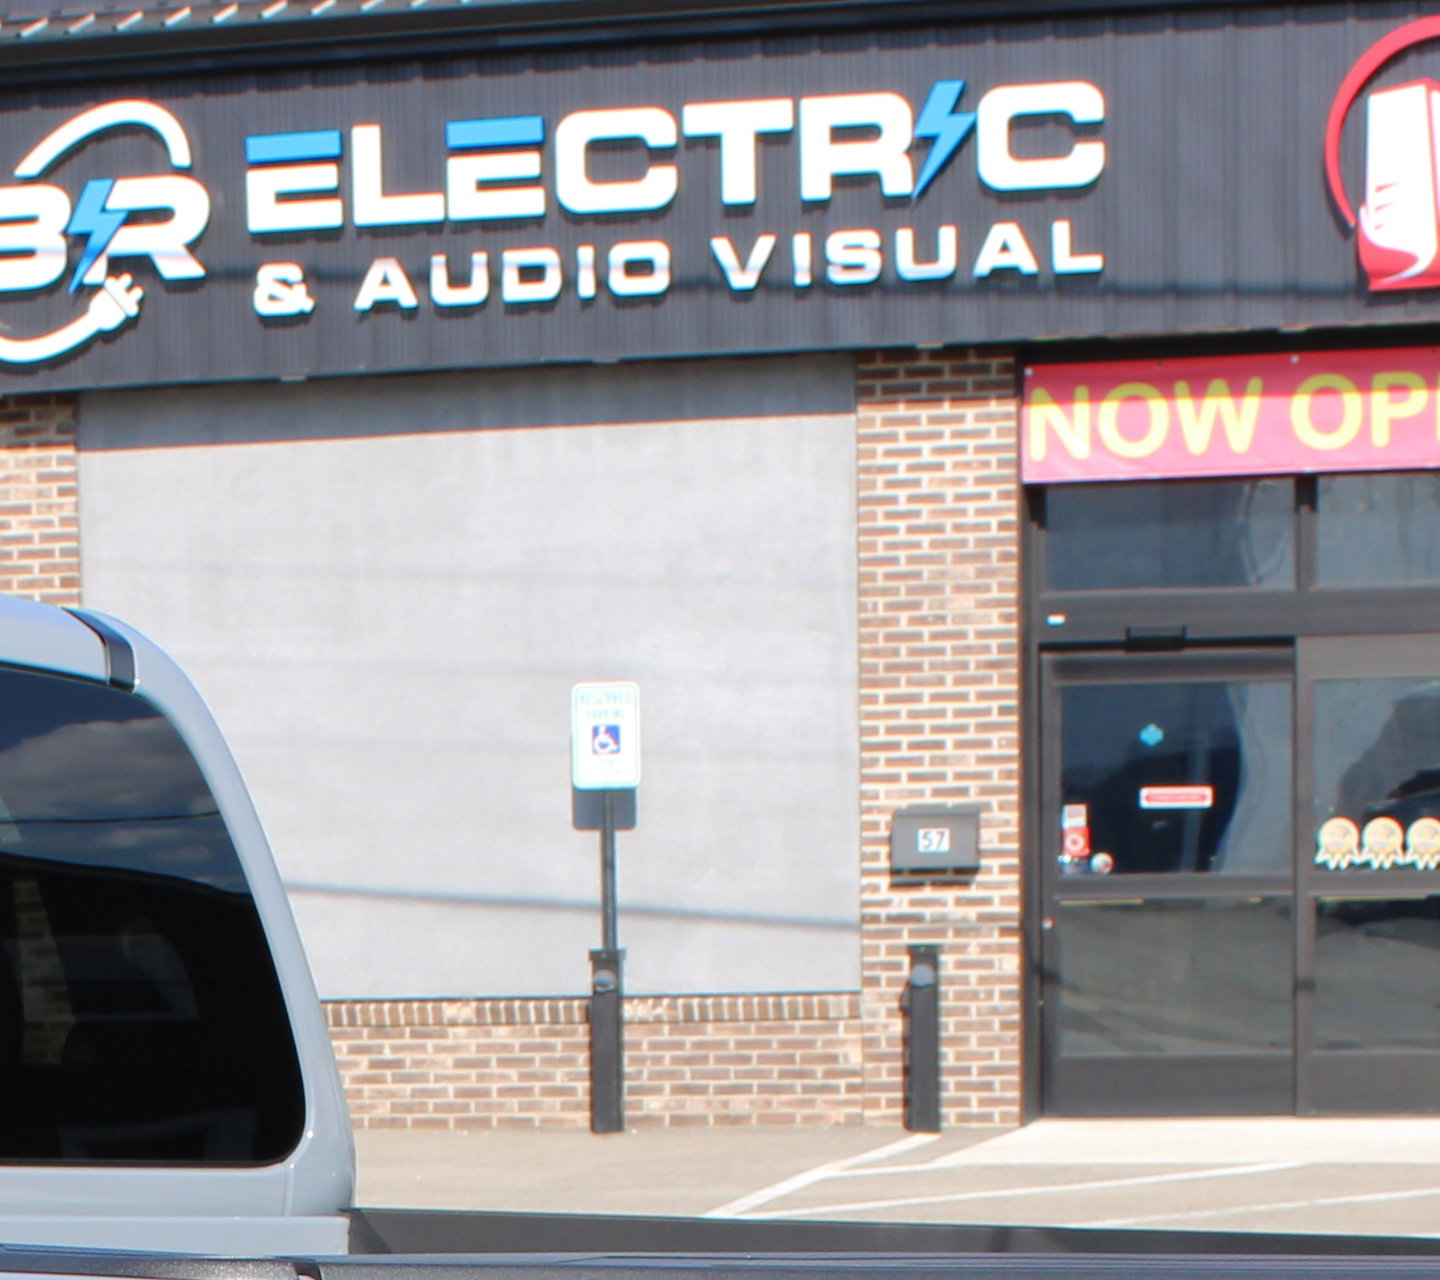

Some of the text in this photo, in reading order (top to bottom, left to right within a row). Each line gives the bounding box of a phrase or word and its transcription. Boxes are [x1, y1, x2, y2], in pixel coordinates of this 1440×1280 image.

[246, 80, 1106, 234] ELECTRIC
[252, 220, 1104, 318] & AUDIO VISUAL
[1027, 376, 1263, 462] NOW
[922, 830, 946, 851] 57
